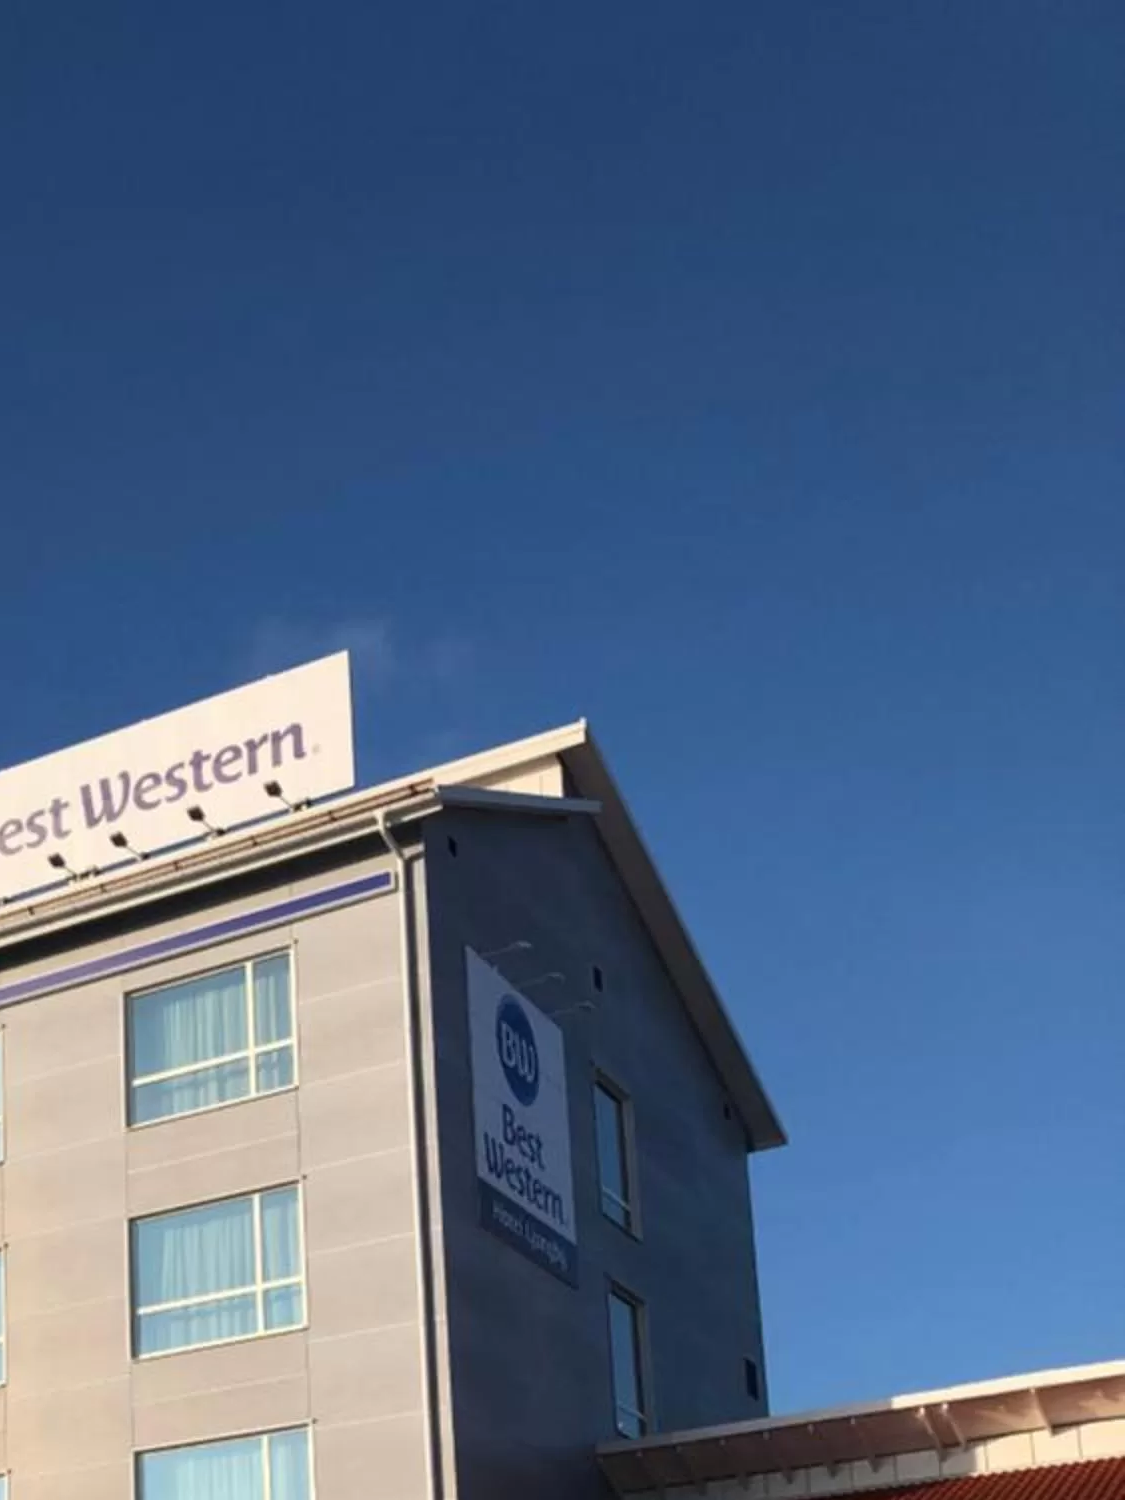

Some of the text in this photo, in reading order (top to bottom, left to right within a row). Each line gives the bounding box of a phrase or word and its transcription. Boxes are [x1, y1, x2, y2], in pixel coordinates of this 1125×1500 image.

[81, 722, 305, 828] Western
[500, 1022, 537, 1083] BW
[501, 1103, 546, 1171] Best
[484, 1132, 565, 1225] Western
